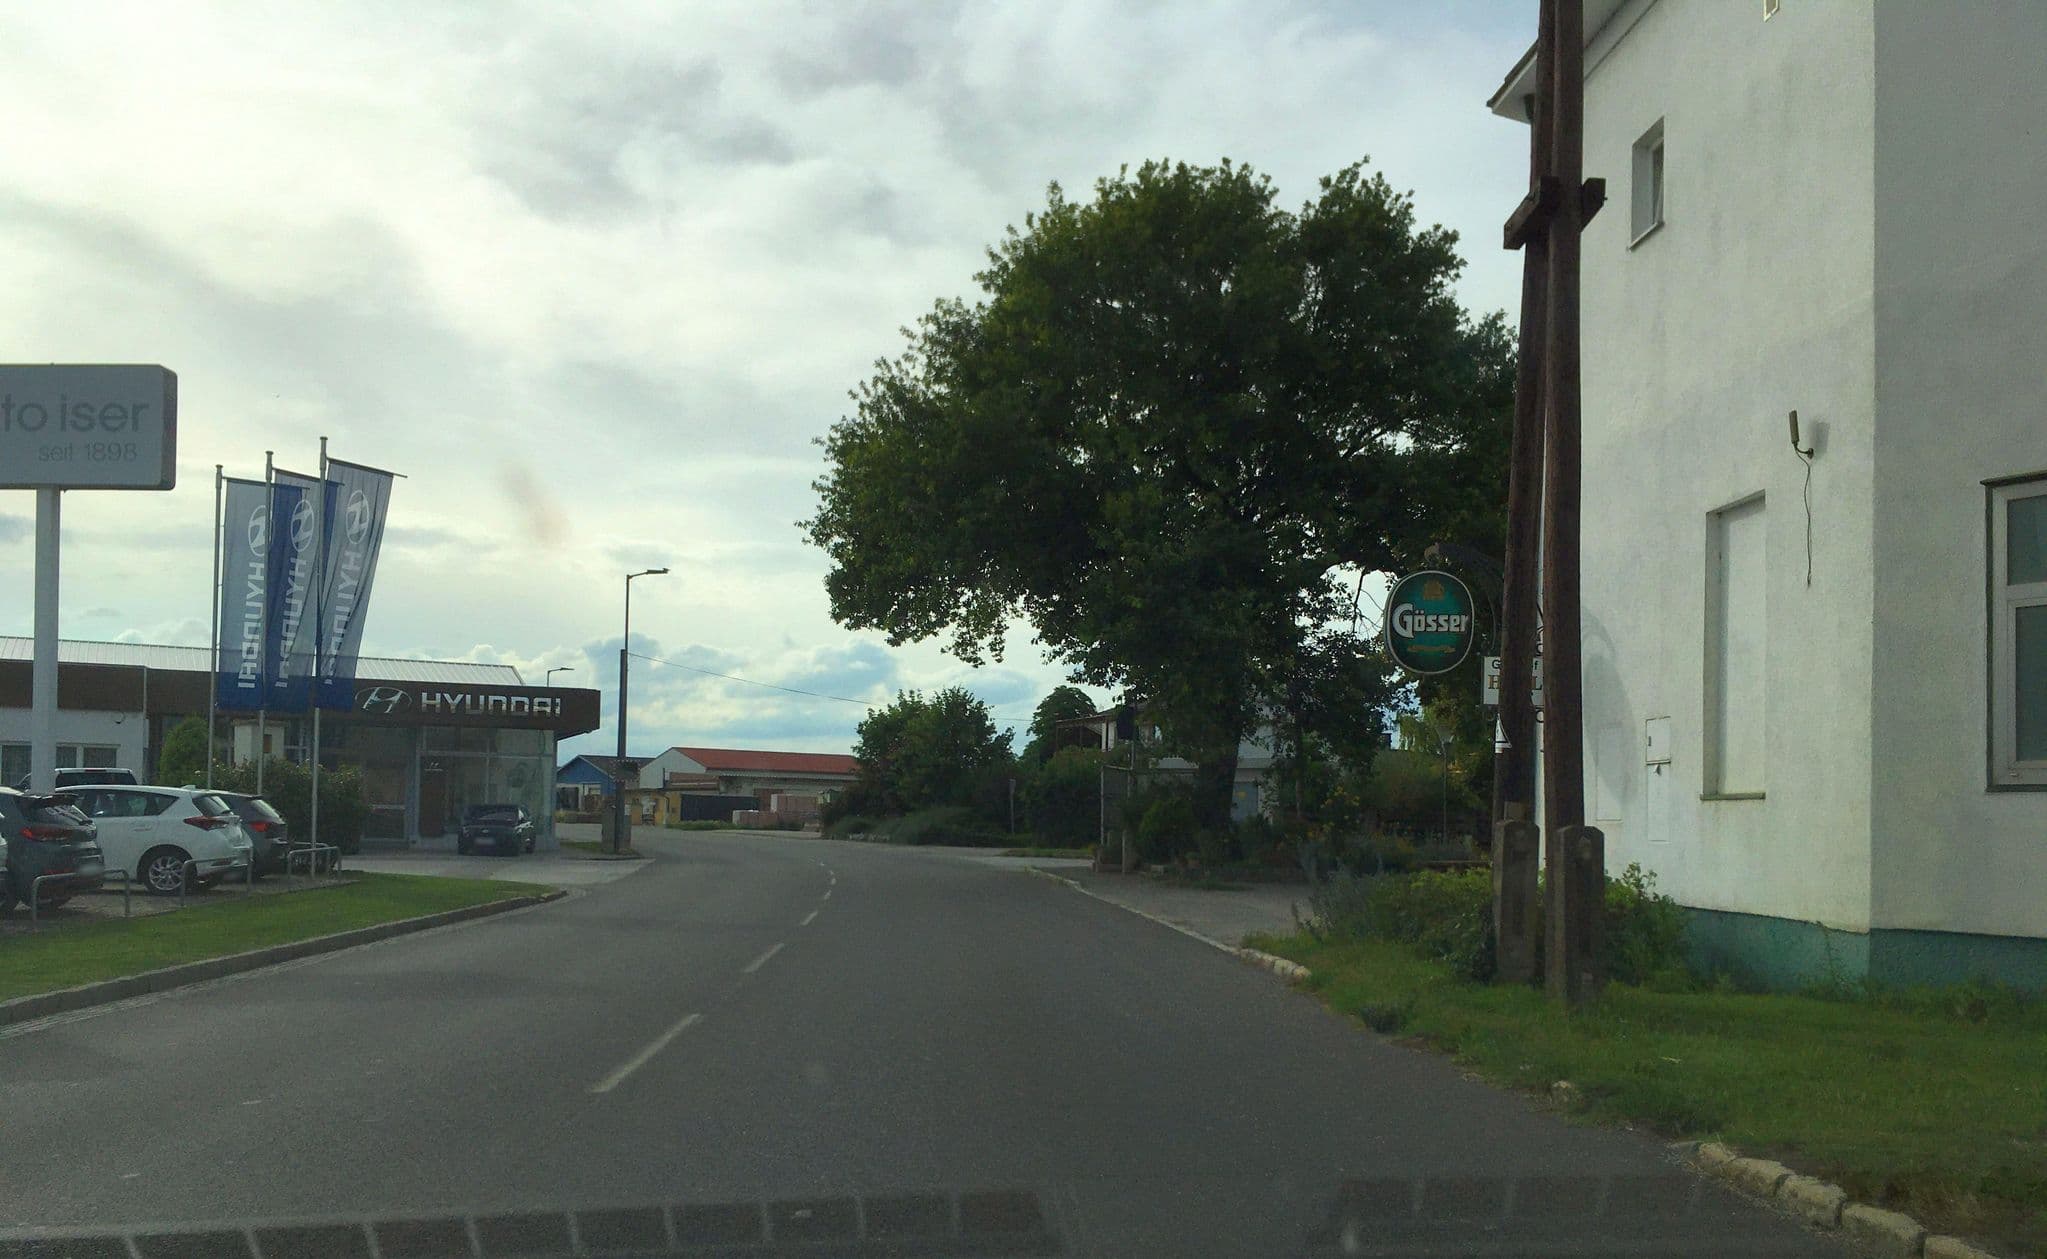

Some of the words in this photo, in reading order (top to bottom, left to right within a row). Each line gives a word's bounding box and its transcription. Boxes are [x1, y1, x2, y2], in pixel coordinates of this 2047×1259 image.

[60, 392, 150, 432] iser
[38, 442, 73, 462] seit
[86, 441, 138, 463] 1898
[1392, 603, 1468, 639] Gösser
[421, 691, 561, 718] HYUNDAI
